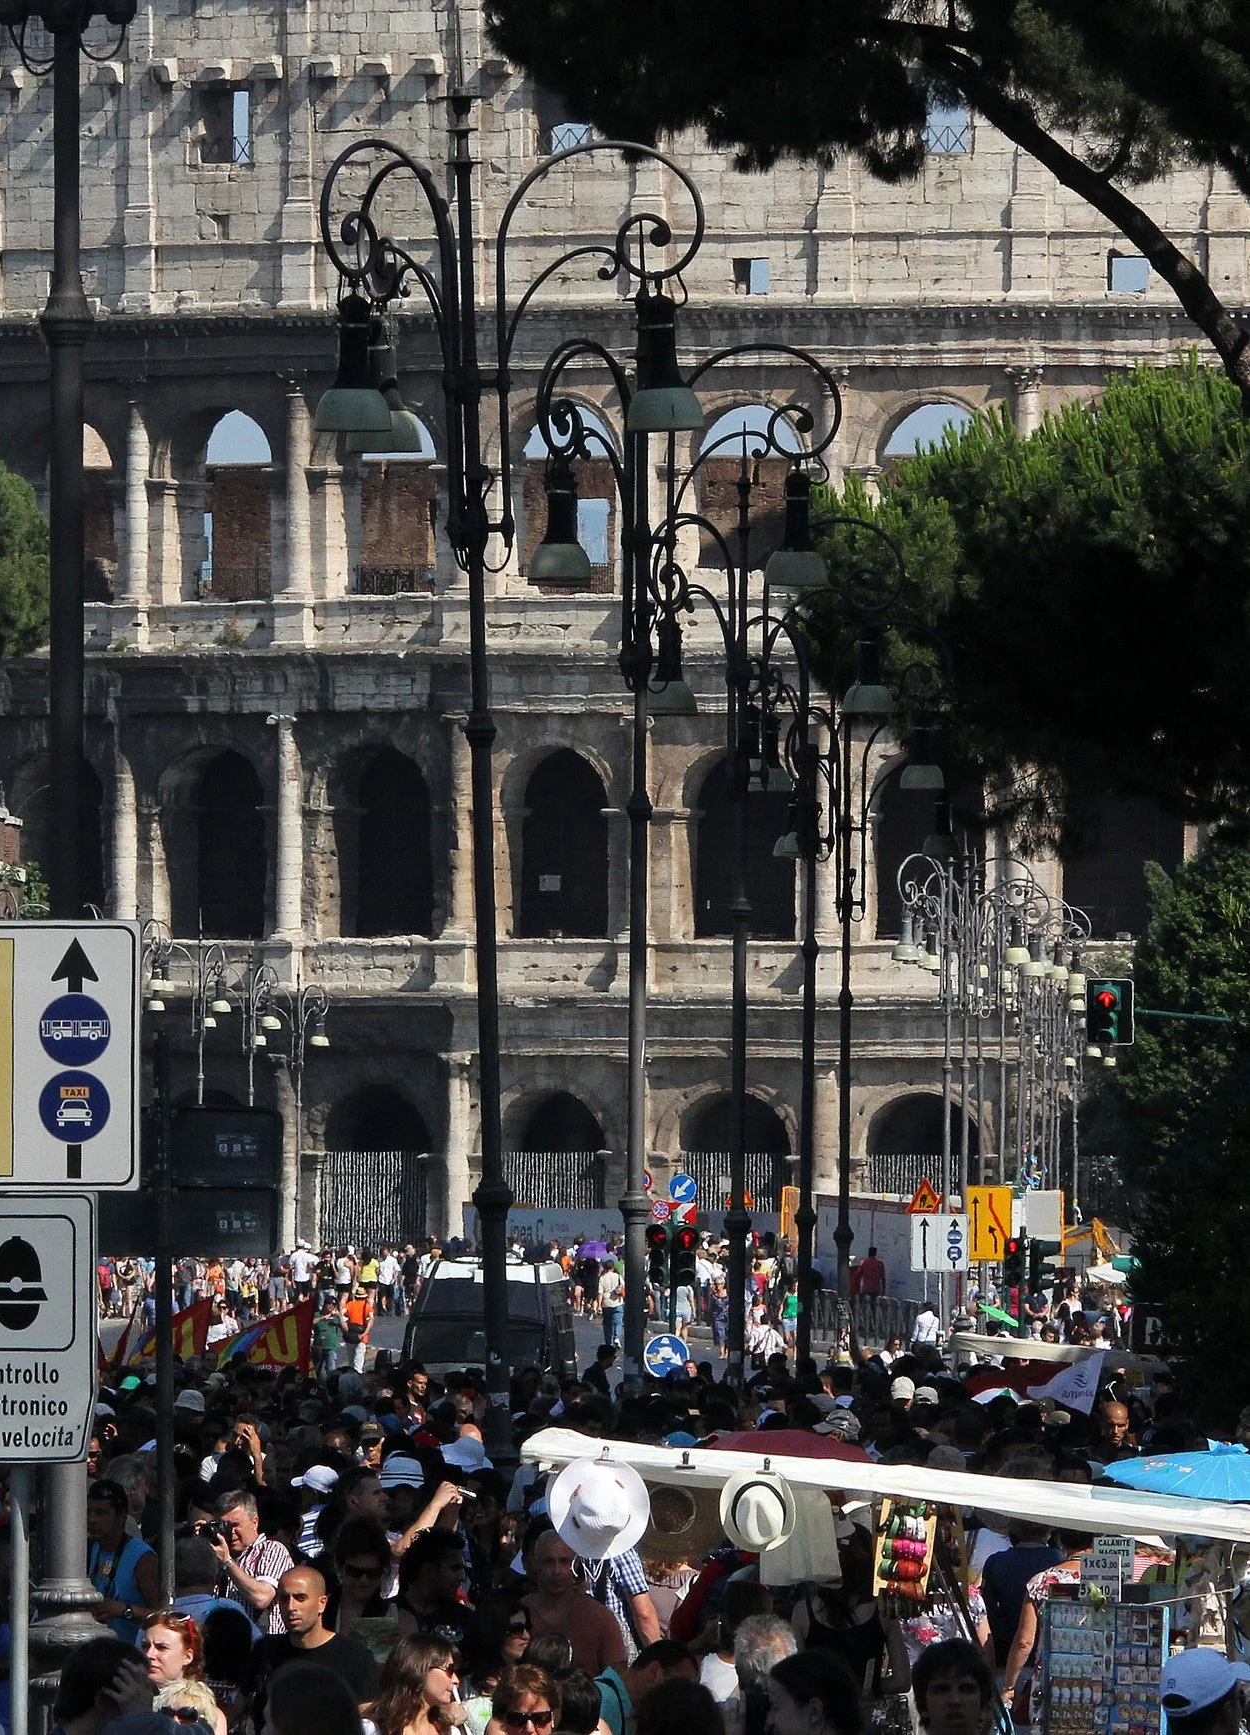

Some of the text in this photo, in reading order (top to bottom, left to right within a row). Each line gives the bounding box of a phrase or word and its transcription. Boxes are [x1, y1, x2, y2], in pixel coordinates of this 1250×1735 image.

[64, 1088, 86, 1097] TAXI
[2, 1424, 81, 1447] velocita'
[1098, 1539, 1131, 1547] CALAMITE
